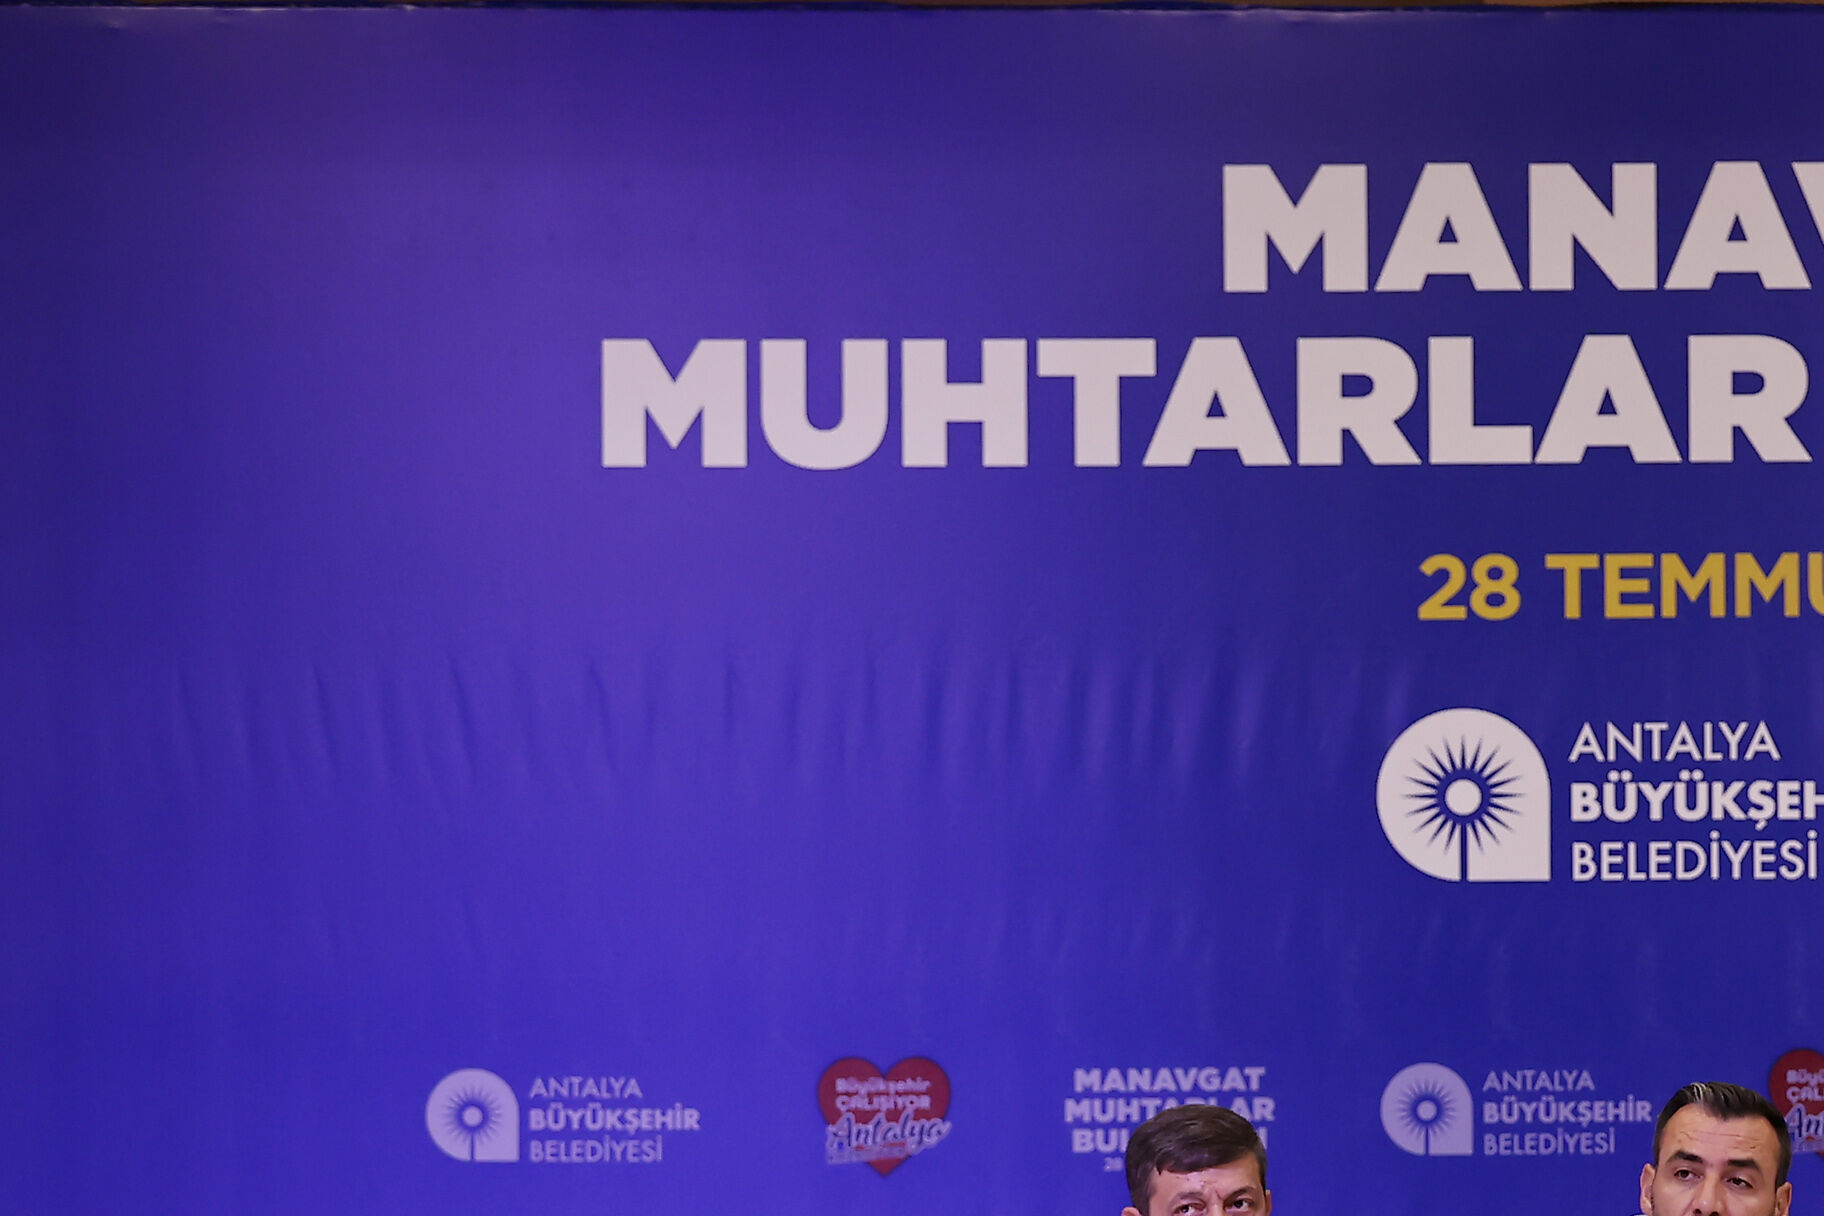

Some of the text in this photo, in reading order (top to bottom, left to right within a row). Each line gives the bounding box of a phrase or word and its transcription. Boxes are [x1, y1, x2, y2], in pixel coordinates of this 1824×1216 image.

[601, 335, 1812, 470] MUHTARLAR
[1419, 554, 1521, 620] 28
[1569, 721, 1780, 762] ANTALYA
[1573, 829, 1817, 881] BELEDİYESİ
[530, 1077, 642, 1099] ANTALYA
[1074, 1067, 1265, 1093] MANAVGAT
[1483, 1070, 1595, 1091] ANTALYA
[530, 1103, 700, 1135] BÜYÜKŞEHİR
[1065, 1097, 1275, 1123] MUHTAR
[1484, 1095, 1651, 1126] BÜYÜKŞEHİR
[530, 1134, 662, 1162] BELEDİYESİ
[826, 1110, 952, 1155] Antalya
[1484, 1127, 1615, 1155] BELEDİYESİ
